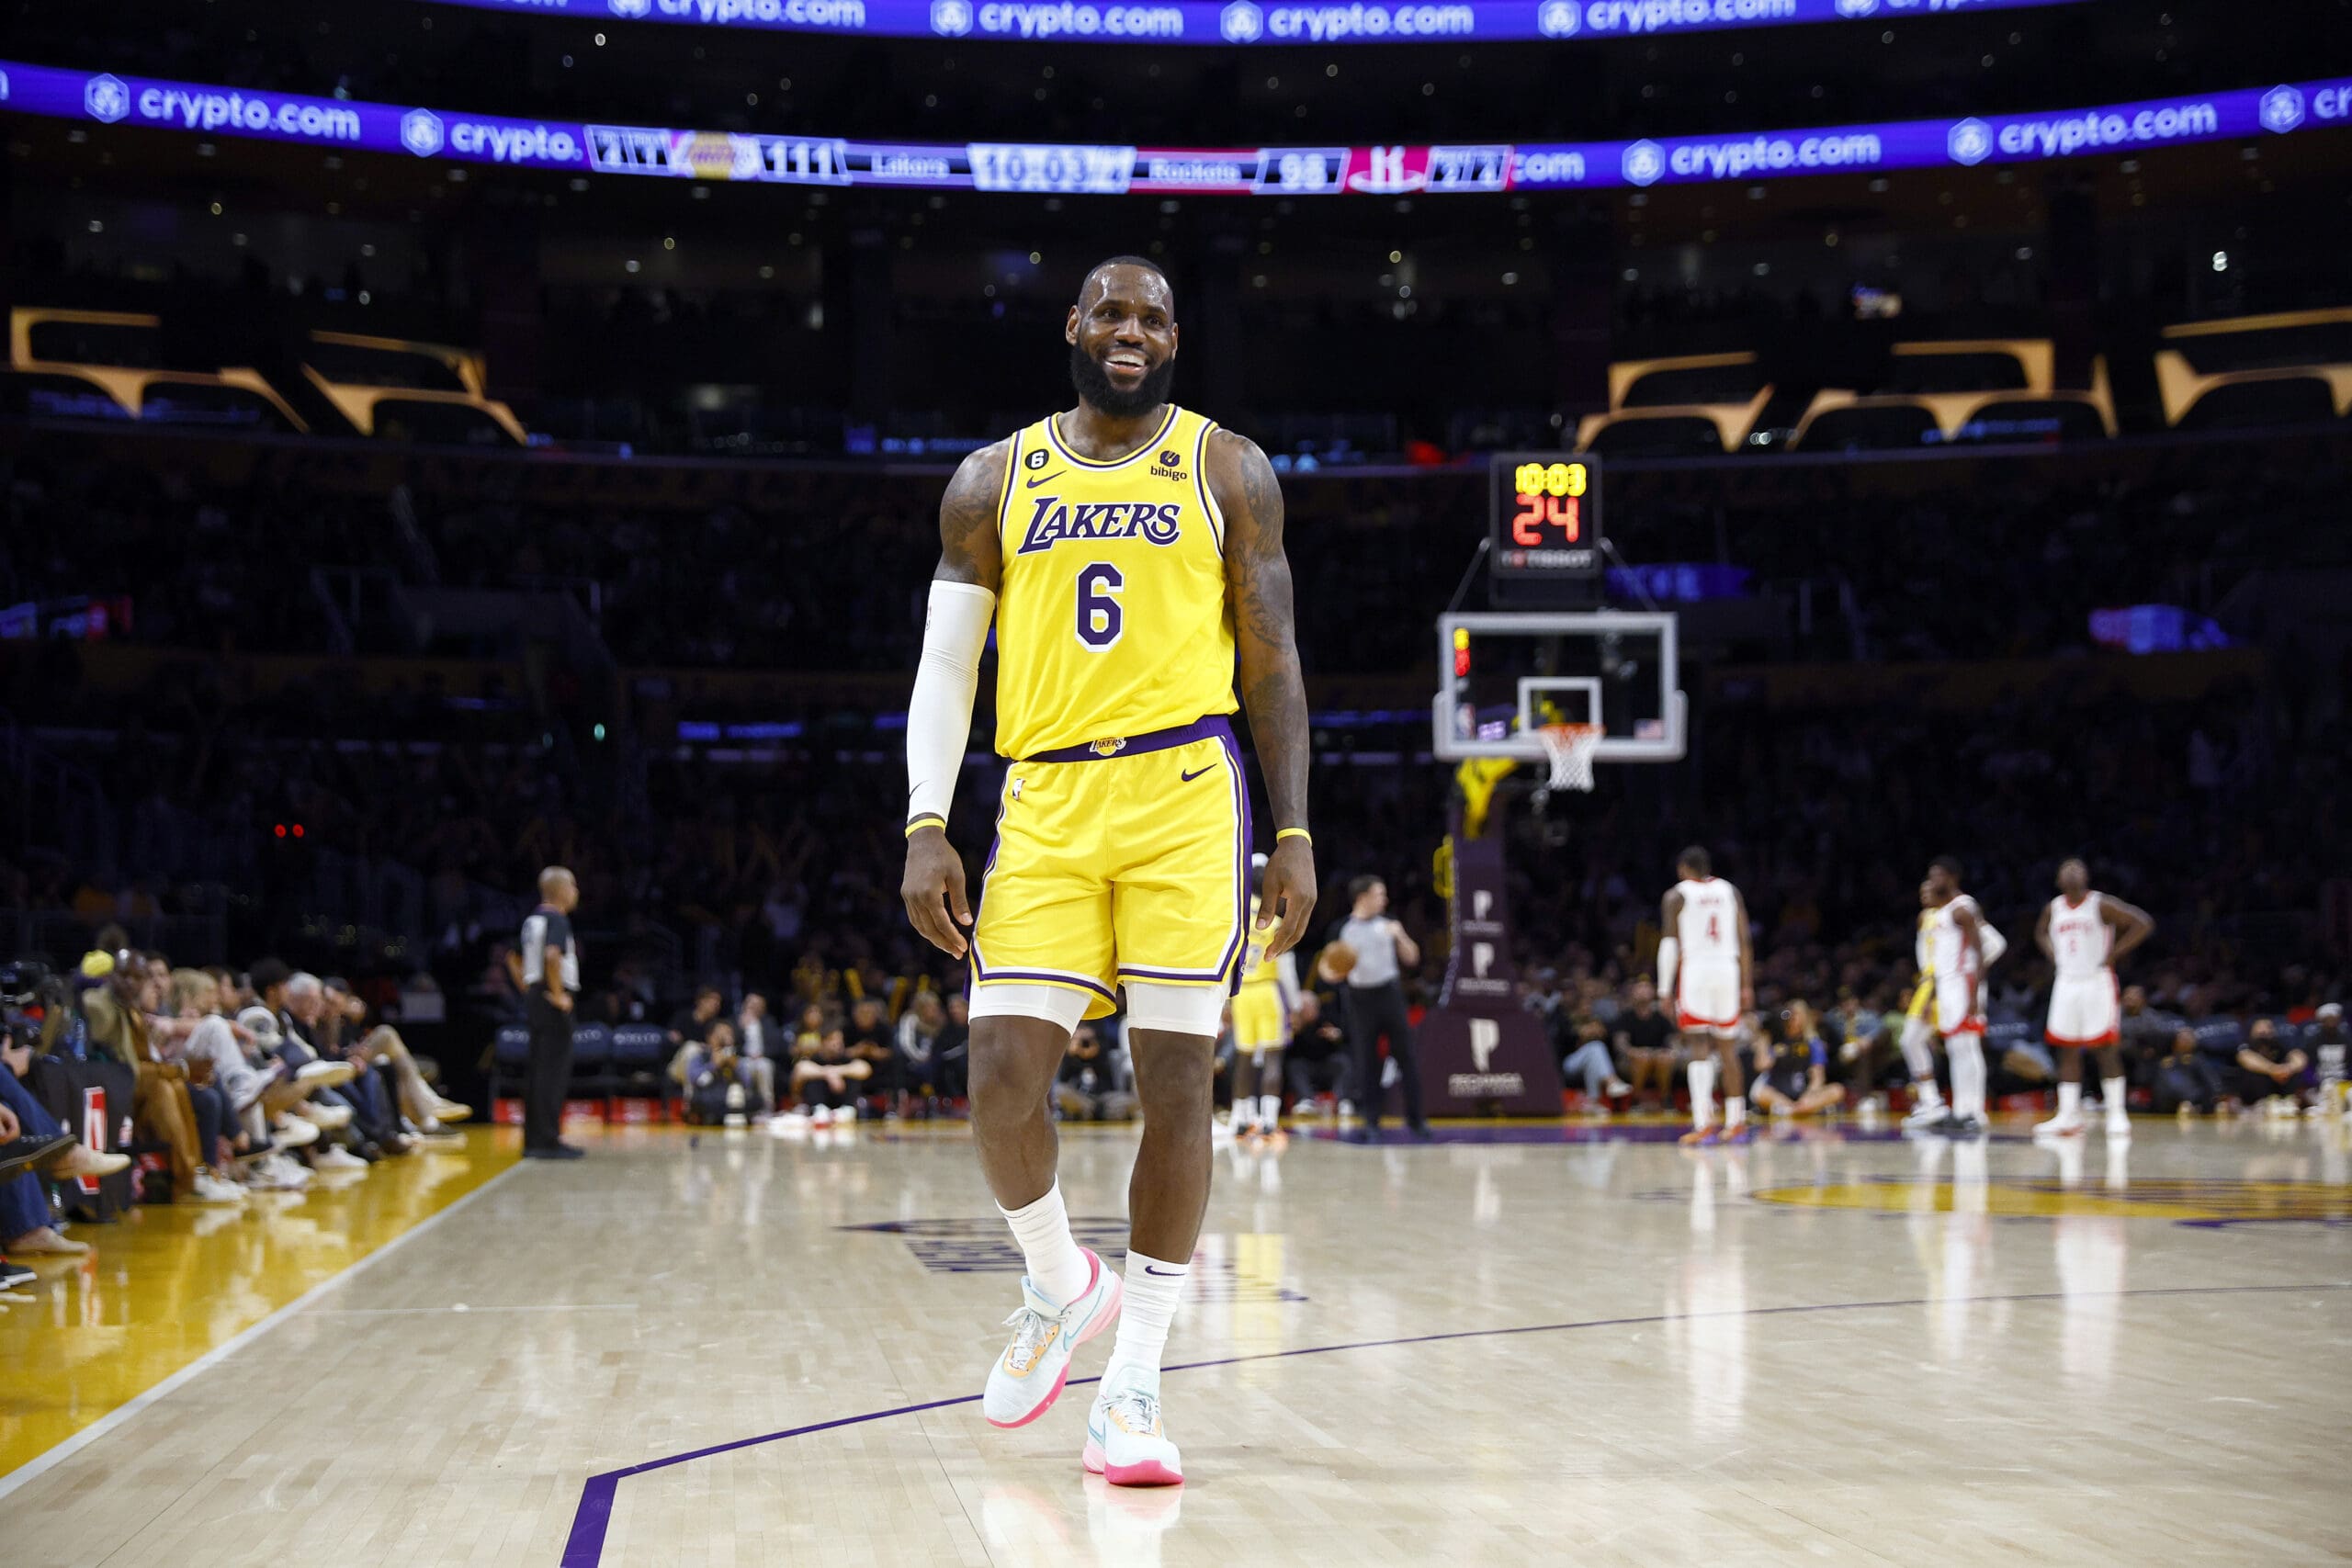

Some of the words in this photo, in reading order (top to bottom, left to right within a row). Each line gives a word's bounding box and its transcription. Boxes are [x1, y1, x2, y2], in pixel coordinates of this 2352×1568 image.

[979, 5, 1183, 38] crypto.com
[1268, 2, 1475, 40] crypto.com
[1587, 0, 1796, 34] crypto.com
[138, 87, 360, 140] crypto.com
[1998, 102, 2218, 157] crypto.com
[450, 122, 582, 163] crypto.
[1670, 133, 1882, 179] crypto.com
[1031, 451, 1044, 468] 6
[1150, 466, 1188, 482] bibigo
[1016, 495, 1181, 556] LAKERS
[1512, 493, 1580, 546] 24
[1075, 560, 1125, 653] 6
